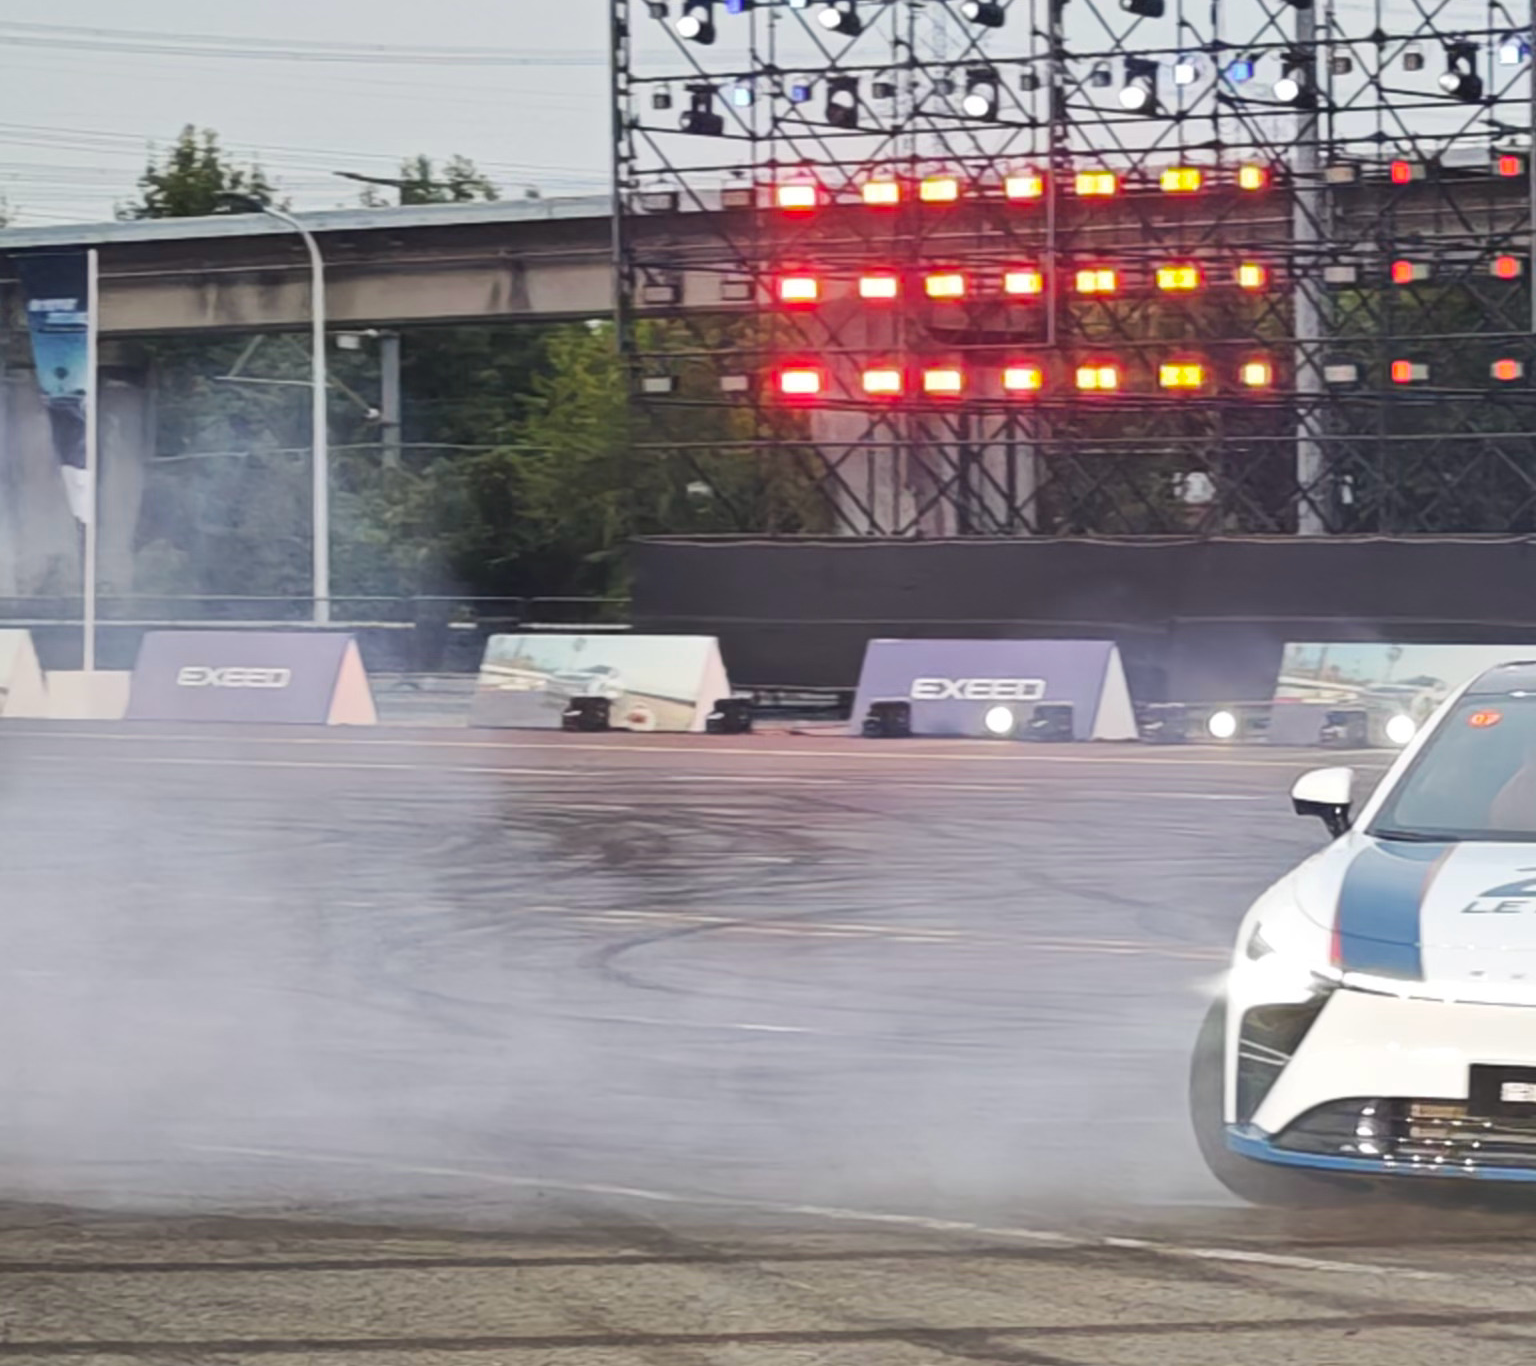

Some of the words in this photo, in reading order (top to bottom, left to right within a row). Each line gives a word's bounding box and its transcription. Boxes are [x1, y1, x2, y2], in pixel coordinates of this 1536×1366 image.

[176, 666, 291, 687] EXEED
[910, 677, 1047, 700] EXEED
[1459, 900, 1530, 914] LE
